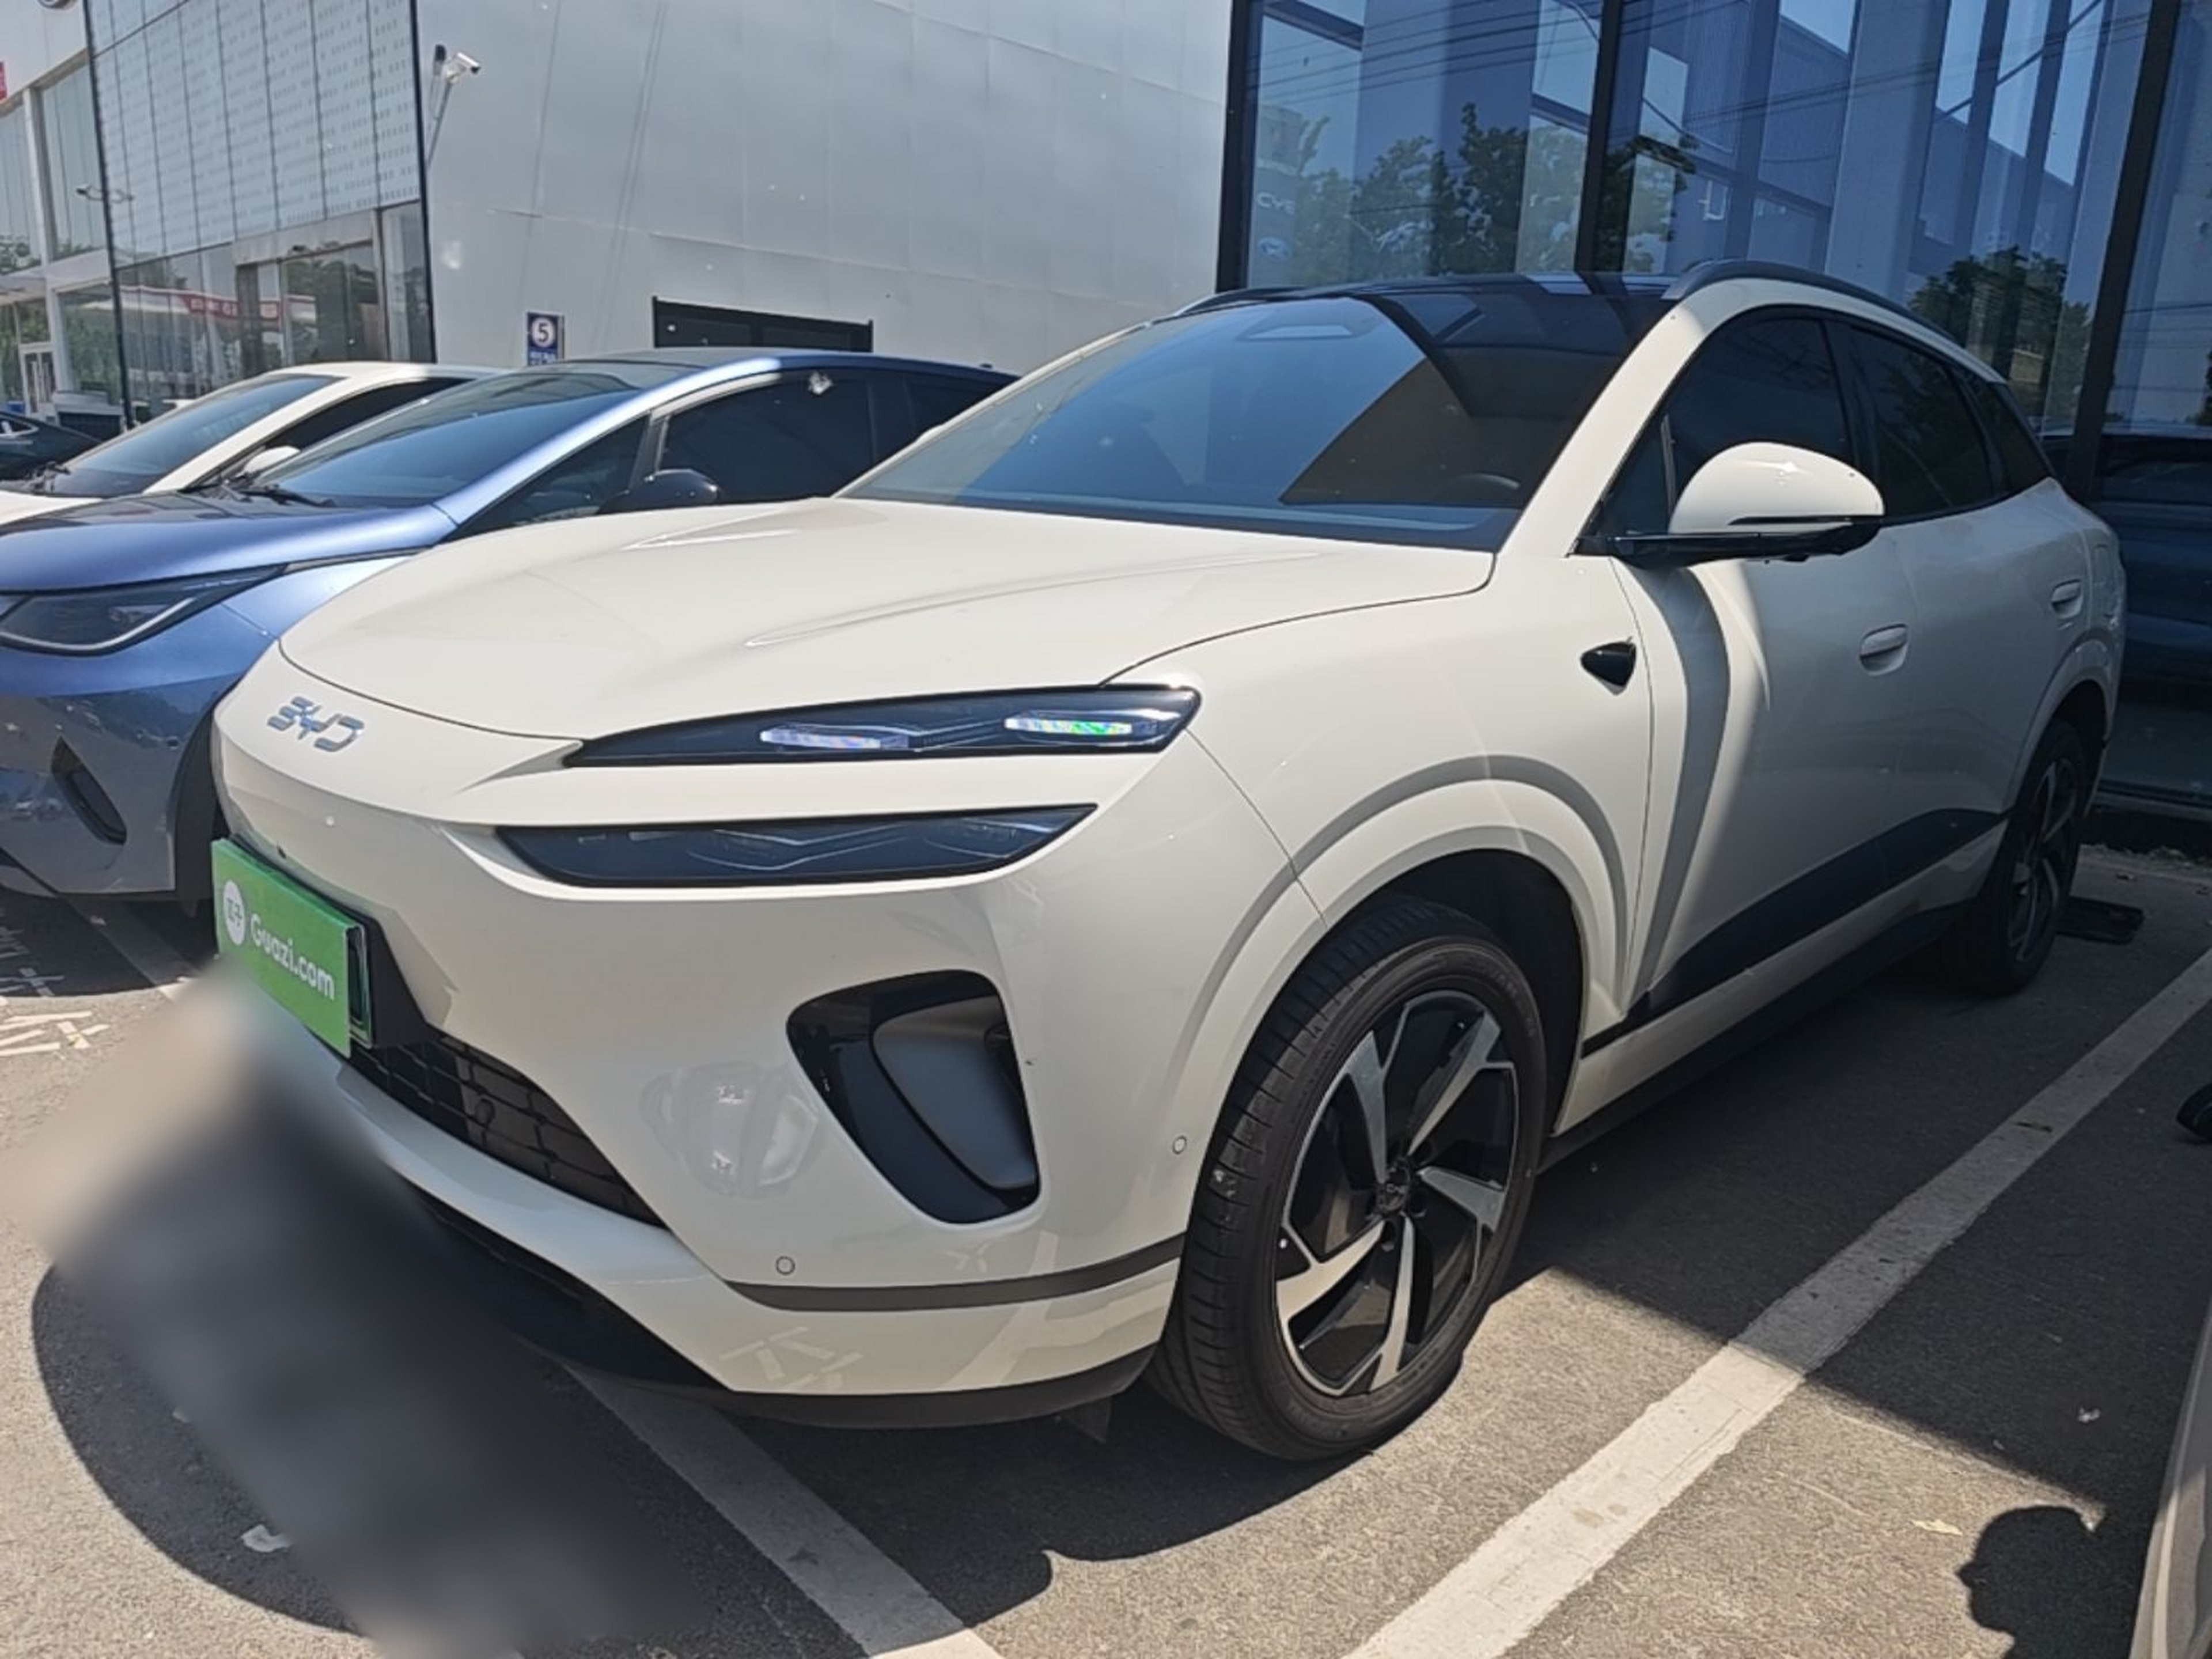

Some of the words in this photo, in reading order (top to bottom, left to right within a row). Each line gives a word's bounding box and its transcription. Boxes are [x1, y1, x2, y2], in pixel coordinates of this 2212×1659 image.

[537, 322, 549, 343] 5
[267, 696, 365, 752] BYD
[251, 913, 335, 1001] Guazi.com
